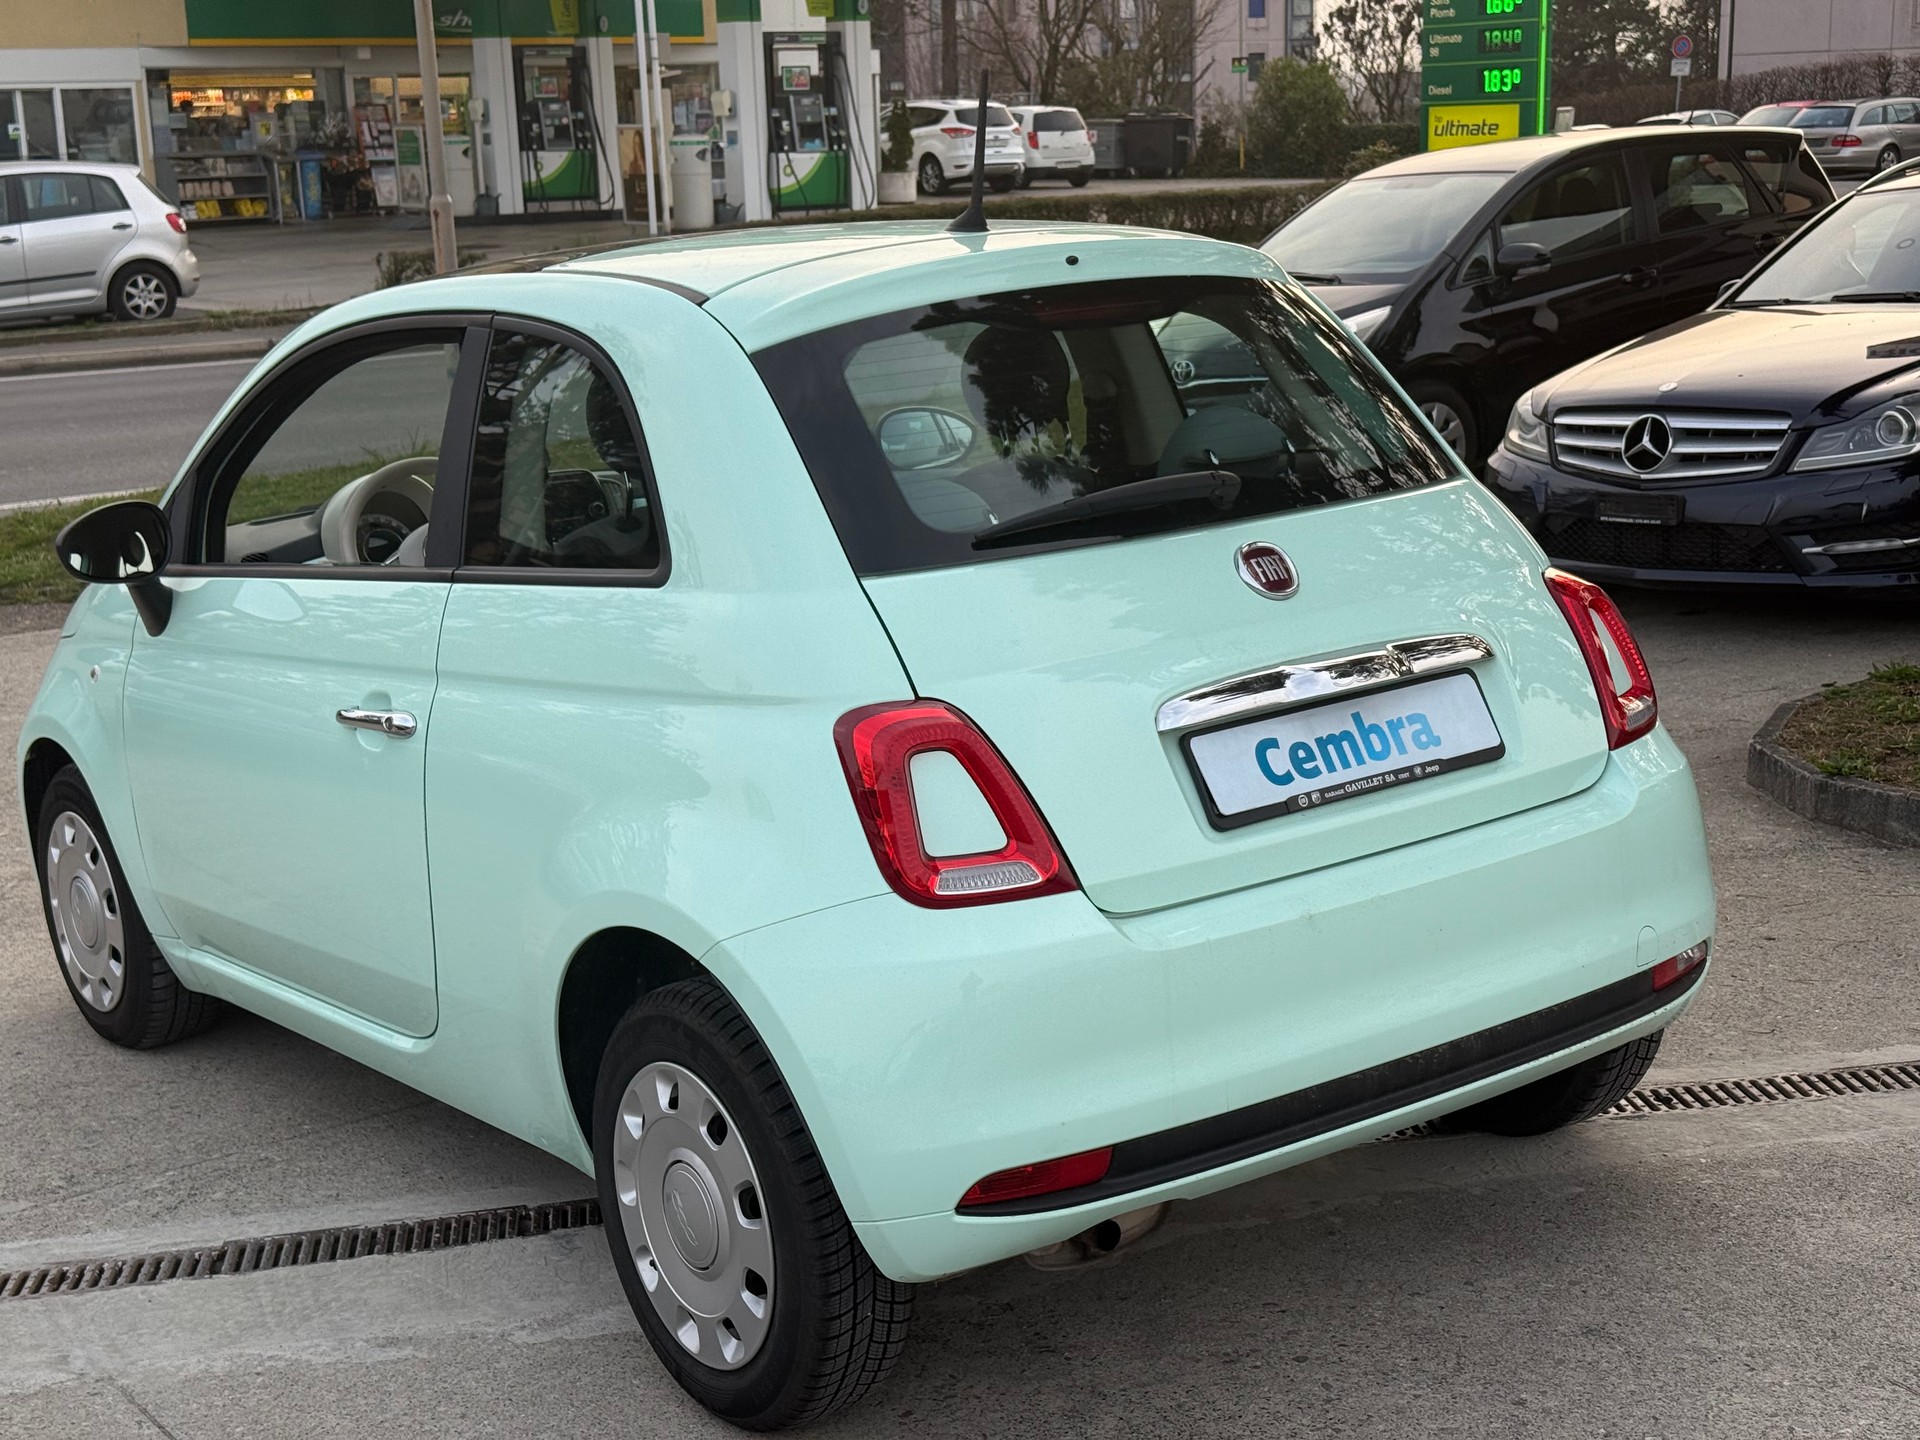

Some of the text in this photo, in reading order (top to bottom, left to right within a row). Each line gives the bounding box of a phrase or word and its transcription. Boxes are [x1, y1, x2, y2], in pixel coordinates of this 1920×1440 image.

[1430, 8, 1456, 18] Plomb
[1429, 34, 1463, 44] Ultimate
[1428, 85, 1452, 95] Diesel
[1434, 119, 1499, 137] ultimate
[1250, 554, 1289, 583] FIAT
[1254, 711, 1442, 786] Cembra
[1424, 764, 1440, 774] Jeep
[1324, 788, 1345, 798] GARAGE
[1345, 775, 1384, 793] GAVILLET
[1384, 773, 1396, 783] SA
